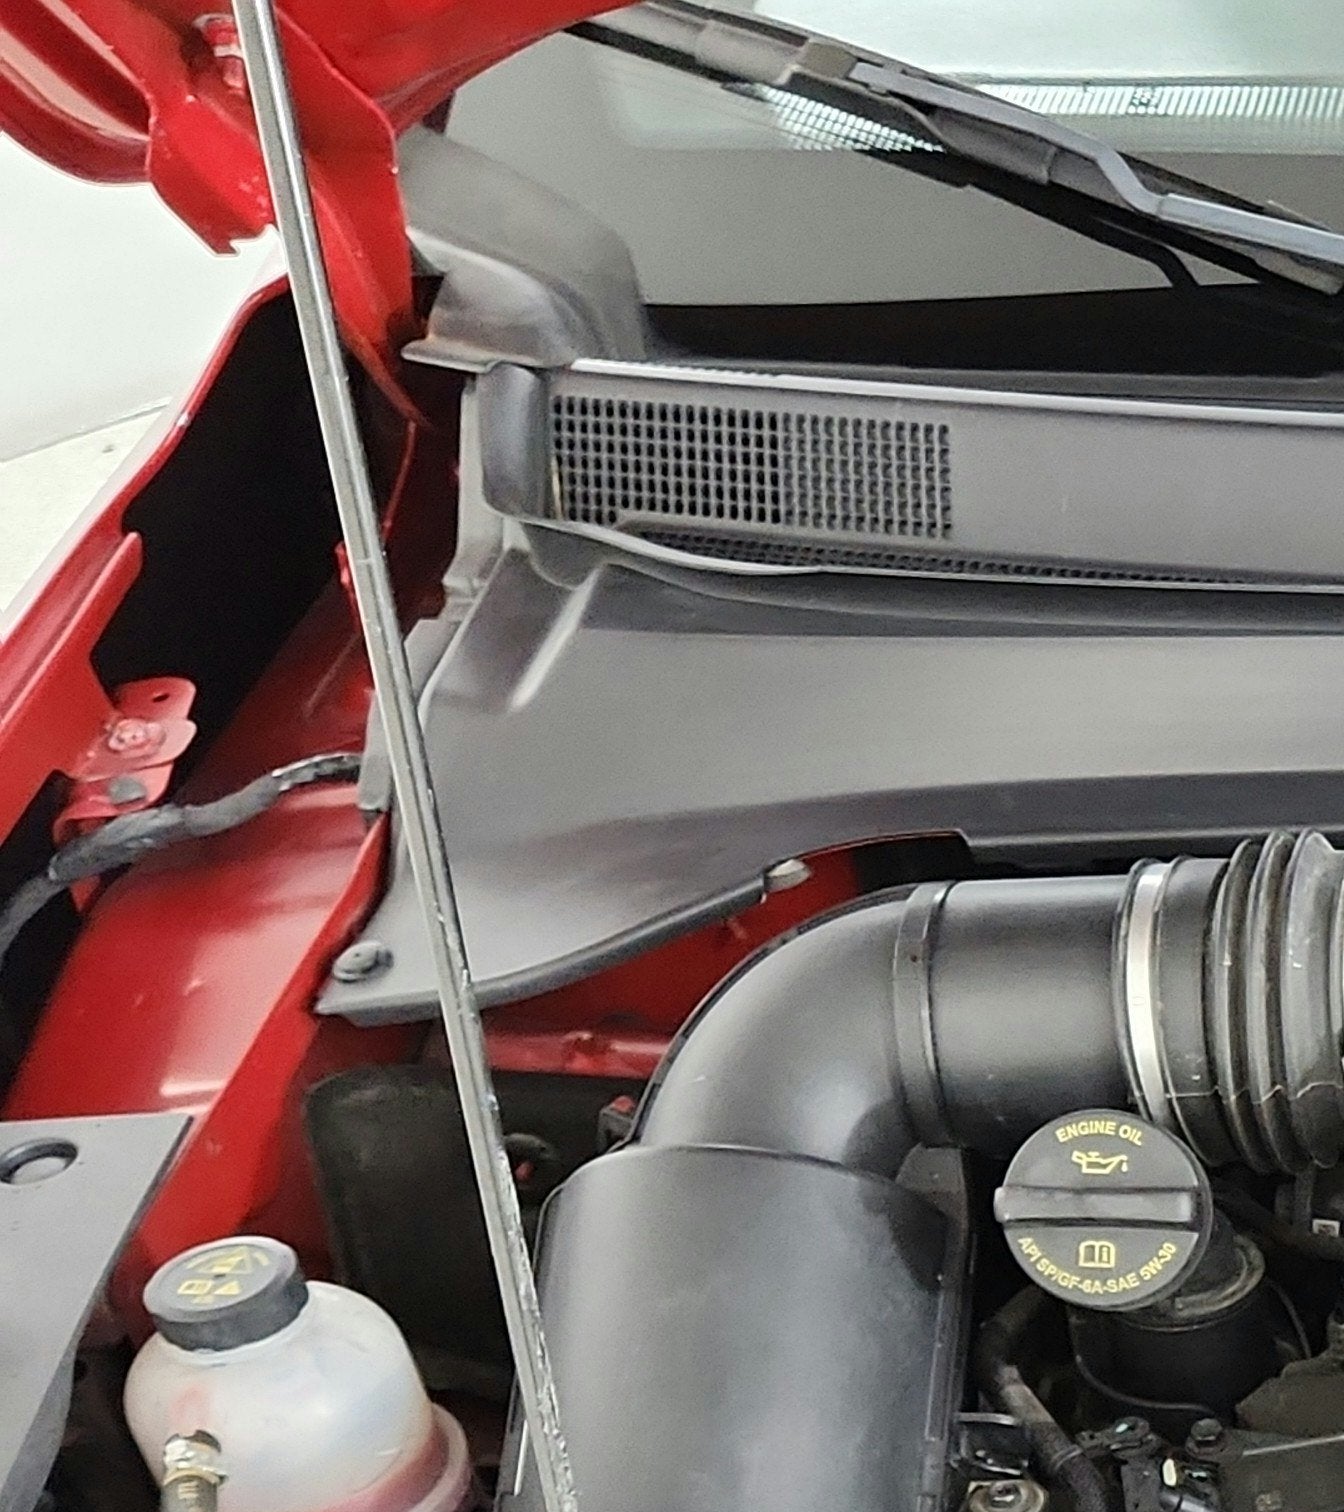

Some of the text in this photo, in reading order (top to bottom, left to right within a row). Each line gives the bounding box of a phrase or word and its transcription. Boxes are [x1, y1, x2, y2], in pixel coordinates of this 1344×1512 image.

[1055, 1120, 1143, 1146] ENGINE OIL
[1017, 1237, 1042, 1263] API
[1139, 1242, 1177, 1281] 5W-30
